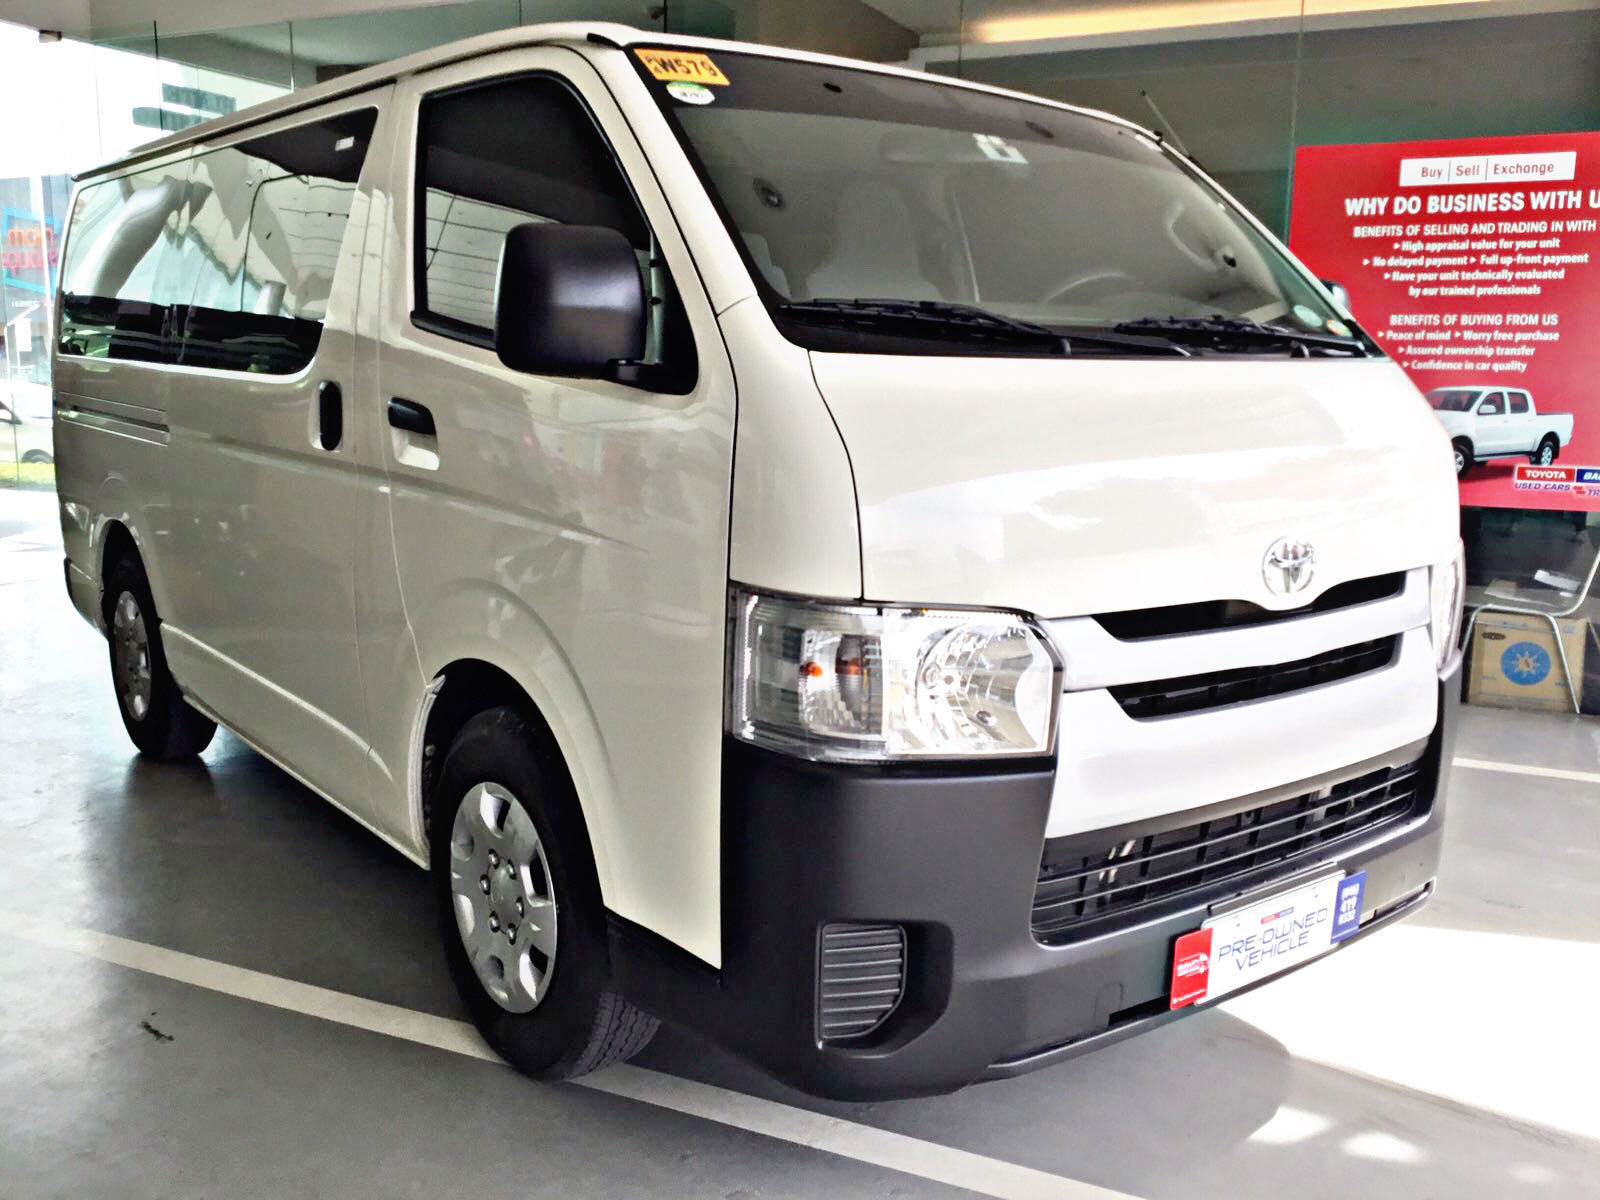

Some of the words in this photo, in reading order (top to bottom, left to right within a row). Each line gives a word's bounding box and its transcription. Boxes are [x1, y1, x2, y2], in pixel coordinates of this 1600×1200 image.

[1421, 166, 1443, 178] Buy
[1456, 165, 1480, 176] Sell
[1494, 162, 1555, 176] Exchange
[1344, 197, 1389, 216] WHY
[1393, 196, 1421, 214] DO
[1427, 192, 1525, 214] BUSINESS
[1530, 190, 1582, 210] WITH
[1353, 225, 1403, 237] BENEFITS
[1406, 224, 1421, 236] OF
[1423, 223, 1469, 236] SELLING
[1471, 223, 1495, 234] AND
[1497, 221, 1547, 234] TRADING
[1551, 221, 1563, 232] IN
[1566, 220, 1597, 232] WITH
[1401, 241, 1424, 253] High
[1425, 239, 1469, 252] appraisal
[1471, 239, 1498, 250] value
[1499, 238, 1514, 249] for
[1515, 240, 1538, 251] your
[1539, 237, 1560, 248] unit
[1373, 256, 1386, 266] No
[1387, 256, 1424, 268] delayed
[1425, 256, 1468, 268] payment
[1480, 254, 1499, 264] Full
[1500, 253, 1542, 266] up-front
[1543, 253, 1589, 266] payment
[1392, 271, 1416, 281] Have
[1416, 273, 1438, 283] your
[1439, 270, 1459, 280] unit
[1461, 269, 1514, 282] technically
[1515, 268, 1565, 279] evaluated
[1408, 285, 1421, 297] by
[1422, 287, 1438, 295] our
[1440, 285, 1475, 295] trained
[1476, 284, 1541, 297] professionals
[1390, 314, 1440, 326] BENEFITS
[1443, 314, 1458, 325] OF
[1461, 314, 1502, 325] BUYING
[1506, 314, 1539, 325] FROM
[1542, 314, 1558, 325] US
[1387, 330, 1413, 340] Peace
[1414, 330, 1426, 340] of
[1426, 330, 1451, 340] mind
[1463, 330, 1492, 342] Worry
[1493, 330, 1513, 340] free
[1514, 330, 1560, 342] purchase
[1406, 345, 1443, 355] Assured
[1445, 345, 1494, 357] ownership
[1495, 345, 1535, 355] transfer
[1411, 360, 1463, 370] Confidence
[1464, 360, 1475, 370] in
[1475, 362, 1491, 370] car
[1492, 361, 1527, 373] quality
[1526, 470, 1567, 479] TOYOTA
[1219, 907, 1328, 960] PRE-OWNED
[1236, 930, 1310, 971] VEHICLE
